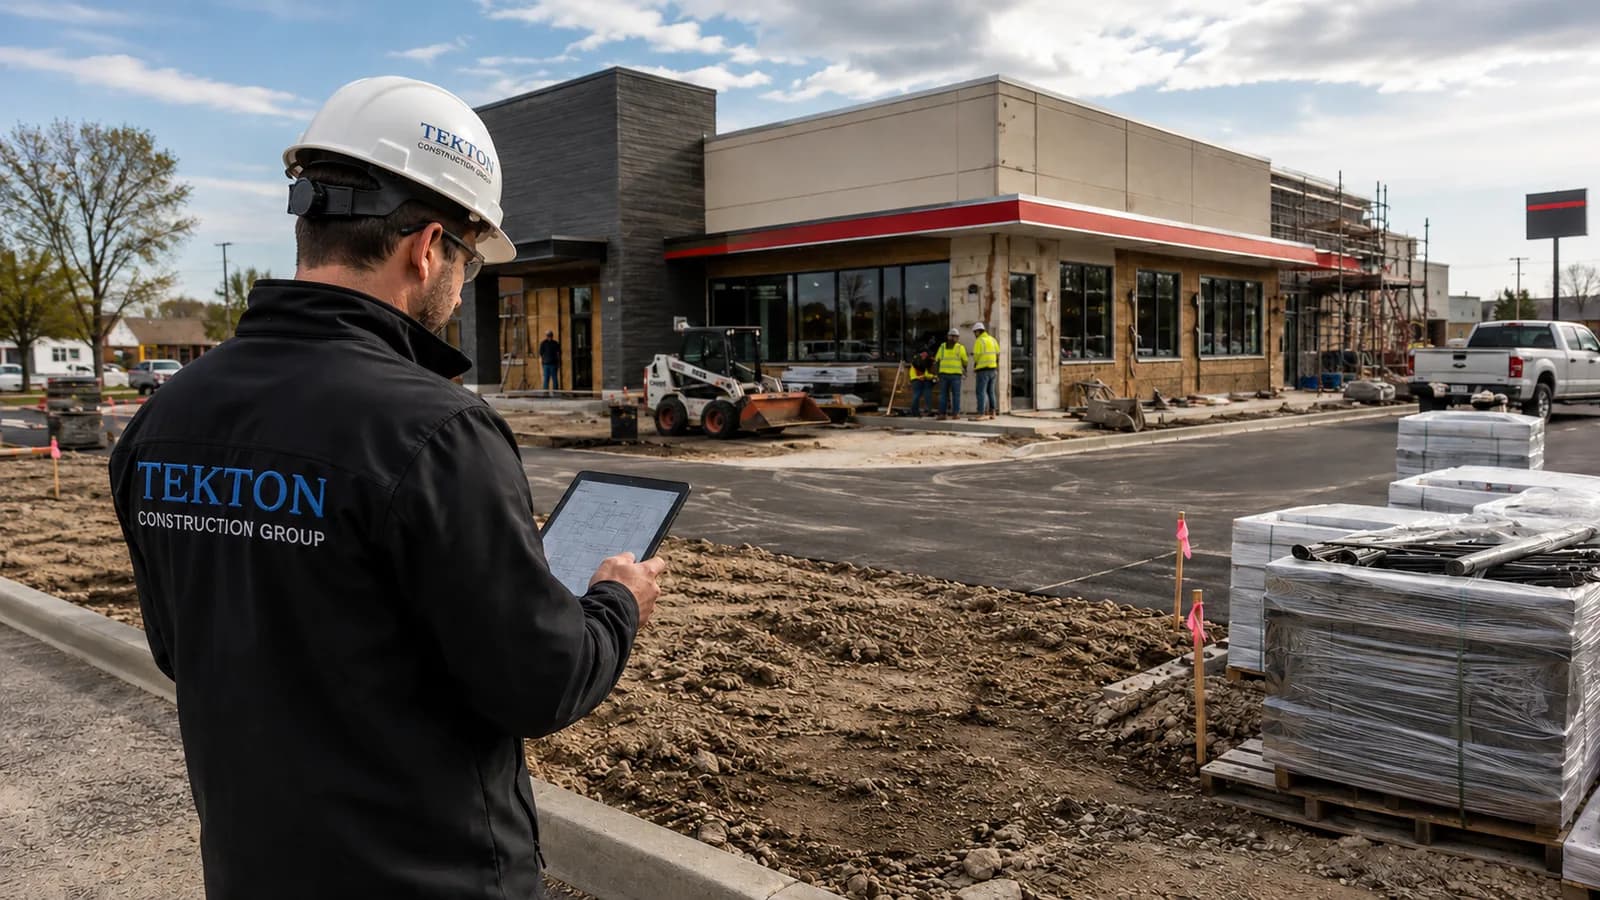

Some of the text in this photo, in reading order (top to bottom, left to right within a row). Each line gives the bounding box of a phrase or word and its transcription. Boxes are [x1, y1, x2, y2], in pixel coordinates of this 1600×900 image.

[418, 142, 475, 172] CONSTRUCTION
[421, 122, 494, 174] TEKTON
[137, 461, 327, 518] TEKTON
[138, 510, 325, 547] CONSTRUCTION GROUP
